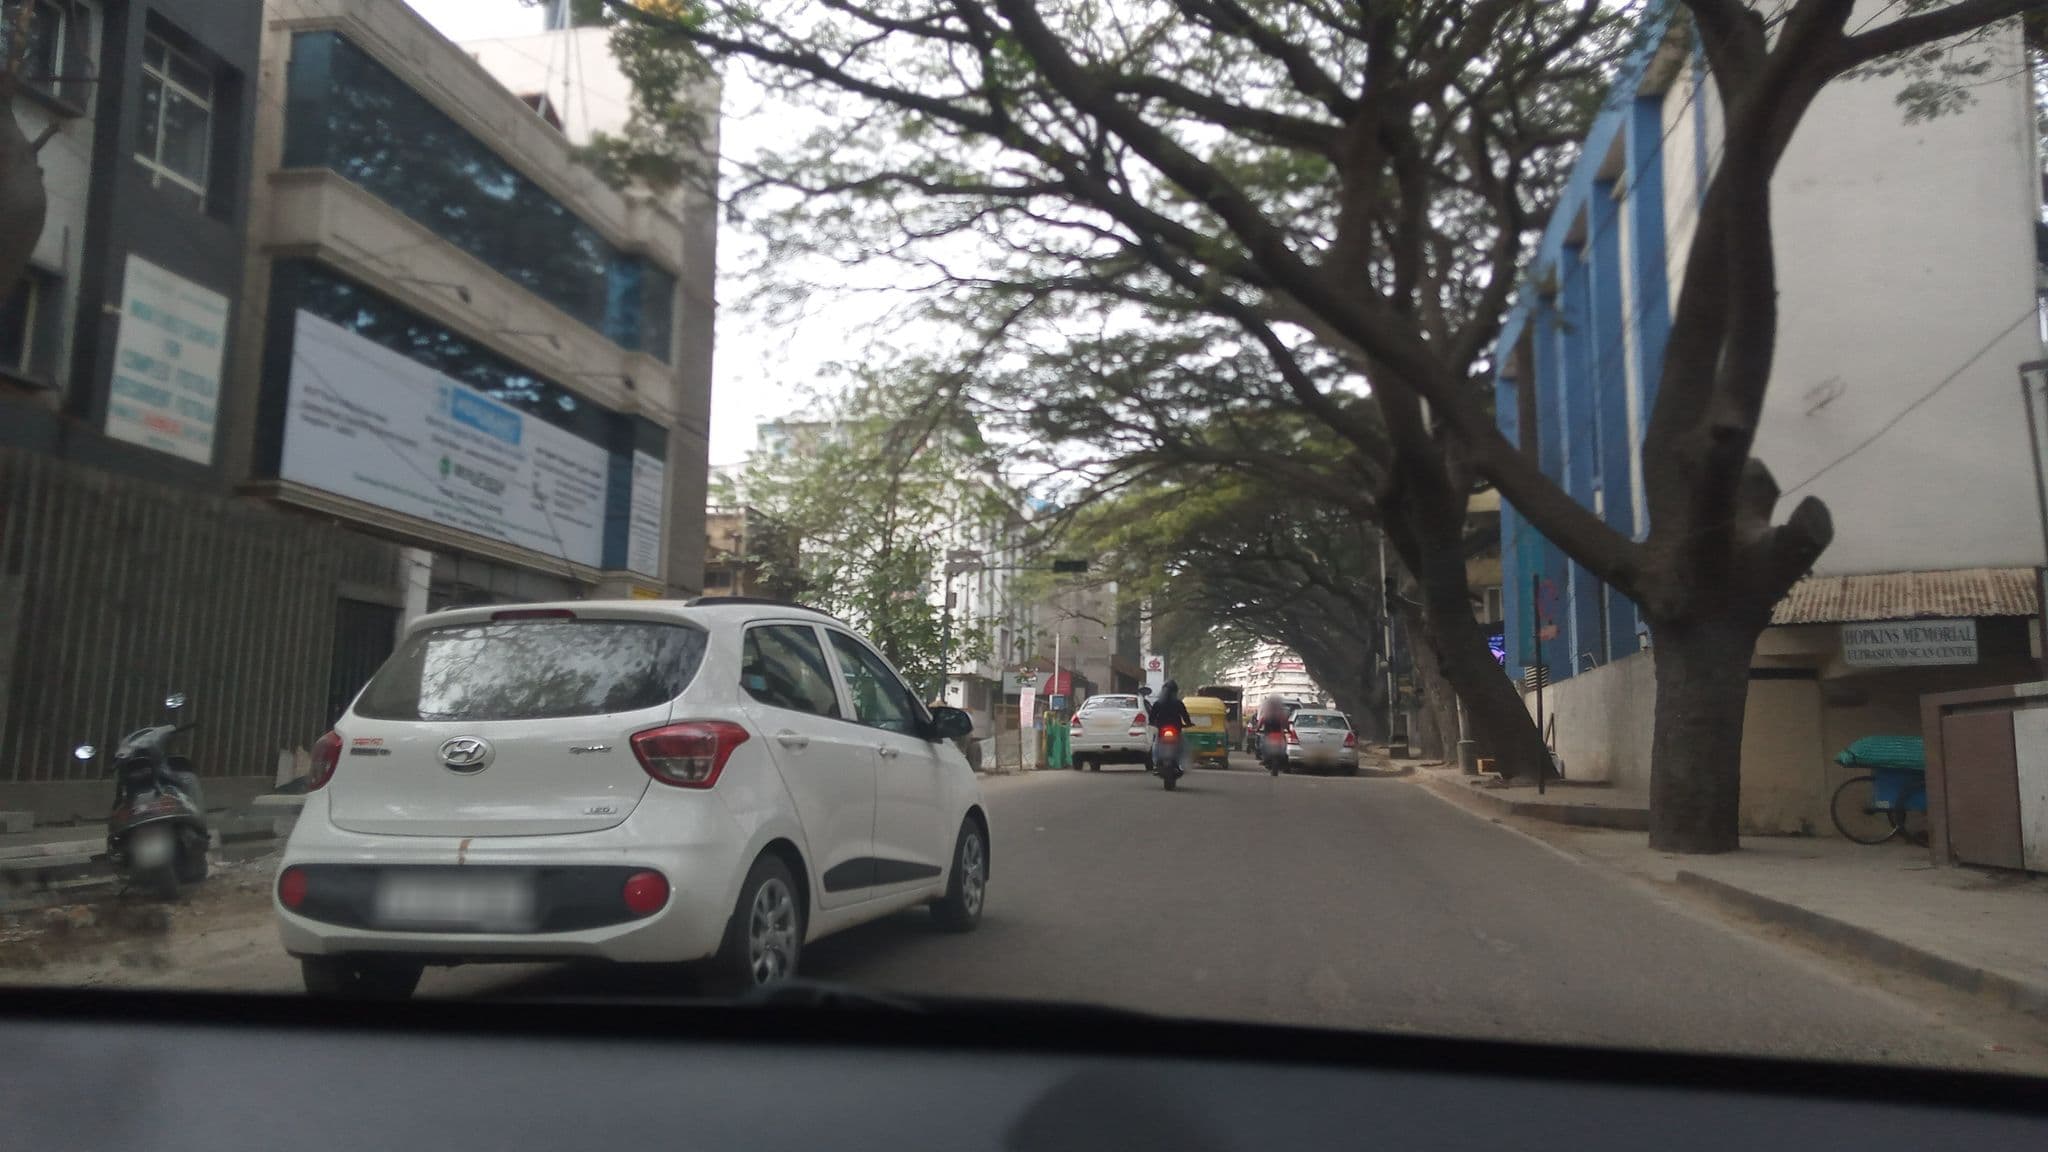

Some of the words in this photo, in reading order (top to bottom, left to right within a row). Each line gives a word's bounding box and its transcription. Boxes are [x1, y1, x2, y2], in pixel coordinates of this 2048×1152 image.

[1843, 628, 1900, 645] HOPKINS
[1902, 626, 1976, 643] MEMORIAL
[1936, 646, 1974, 658] CENTRE
